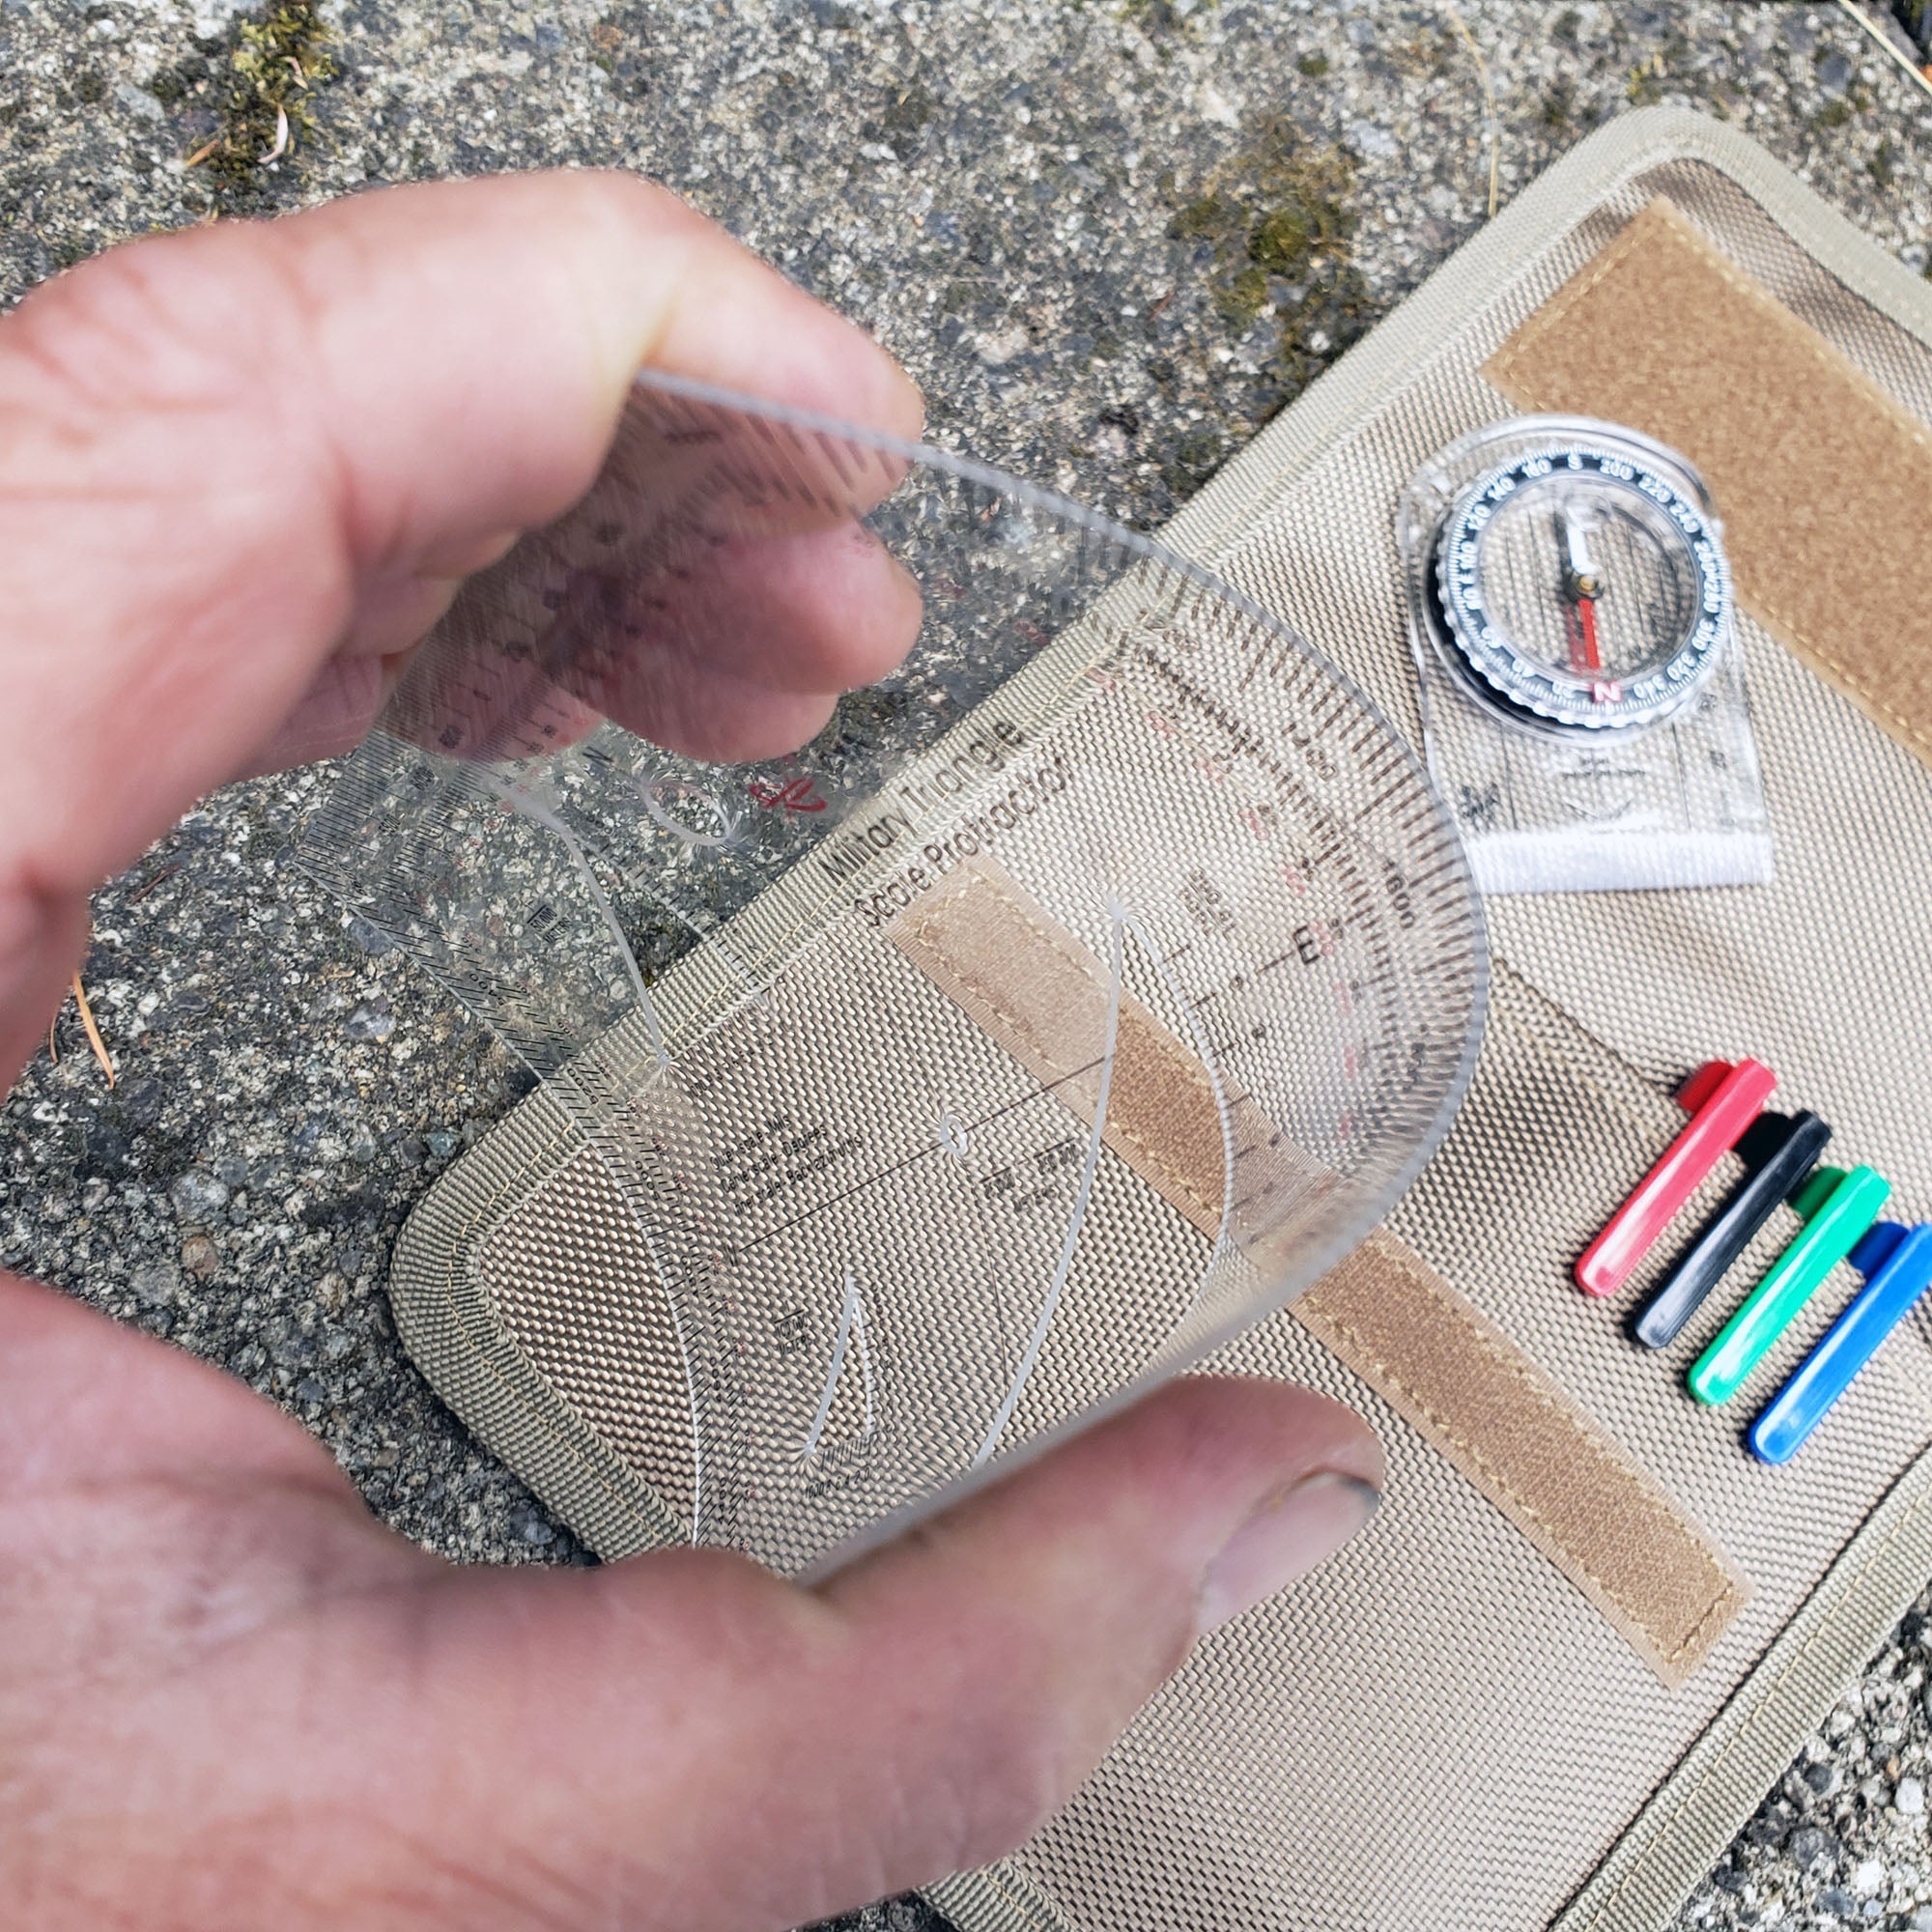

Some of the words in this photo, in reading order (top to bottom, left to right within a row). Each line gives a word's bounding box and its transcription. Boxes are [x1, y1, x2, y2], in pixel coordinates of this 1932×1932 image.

[1593, 682, 1621, 702] N
[816, 804, 923, 886] Military
[899, 721, 1024, 812] Triangle
[854, 863, 933, 929] Scale
[923, 756, 1075, 868] Protractor
[529, 907, 557, 932] 50,000
[543, 914, 573, 944] METERS
[1293, 924, 1321, 965] E
[469, 972, 505, 1007] 5400
[567, 1067, 600, 1105] 5200
[710, 1149, 735, 1171] Outer
[739, 1131, 764, 1154] scale
[767, 1114, 791, 1135] Mils
[753, 1151, 778, 1177] scale
[782, 1124, 827, 1157] Degrees
[636, 1160, 661, 1201] 5000
[756, 1179, 783, 1205] scale
[786, 1164, 814, 1185] Back
[709, 1356, 723, 1403] 4600
